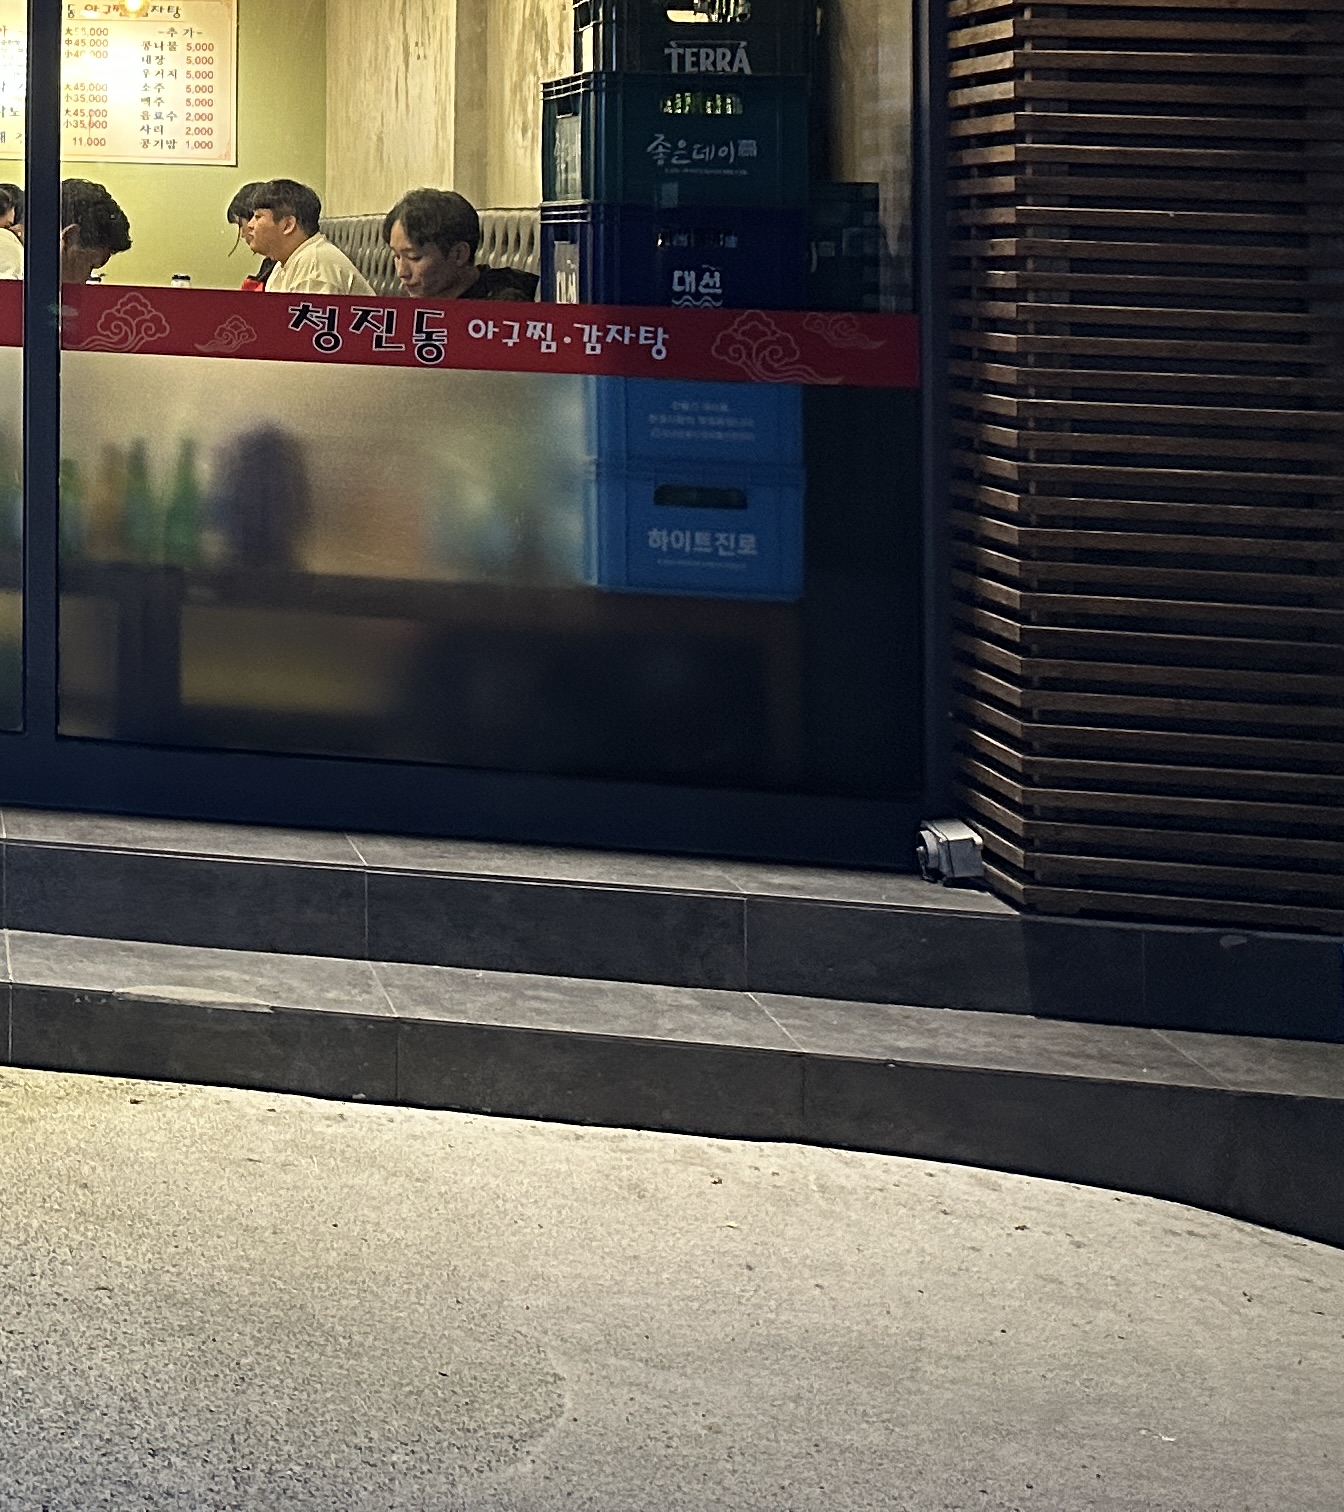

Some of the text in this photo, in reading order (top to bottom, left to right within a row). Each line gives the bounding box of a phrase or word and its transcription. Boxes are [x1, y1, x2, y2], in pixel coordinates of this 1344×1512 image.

[186, 42, 215, 52] 5,000
[186, 56, 214, 65] 5,000
[664, 43, 752, 75] TERRA
[185, 70, 214, 80] 5,000
[185, 85, 214, 94] 5,000
[185, 98, 214, 108] 5,000
[185, 112, 214, 122] 2,000
[185, 126, 214, 136] 2,000
[185, 140, 214, 150] 1,000
[645, 133, 736, 166] 좋은데이
[672, 269, 723, 295] 대선
[287, 302, 449, 365] 청진동
[648, 528, 759, 557] 하이트진로
